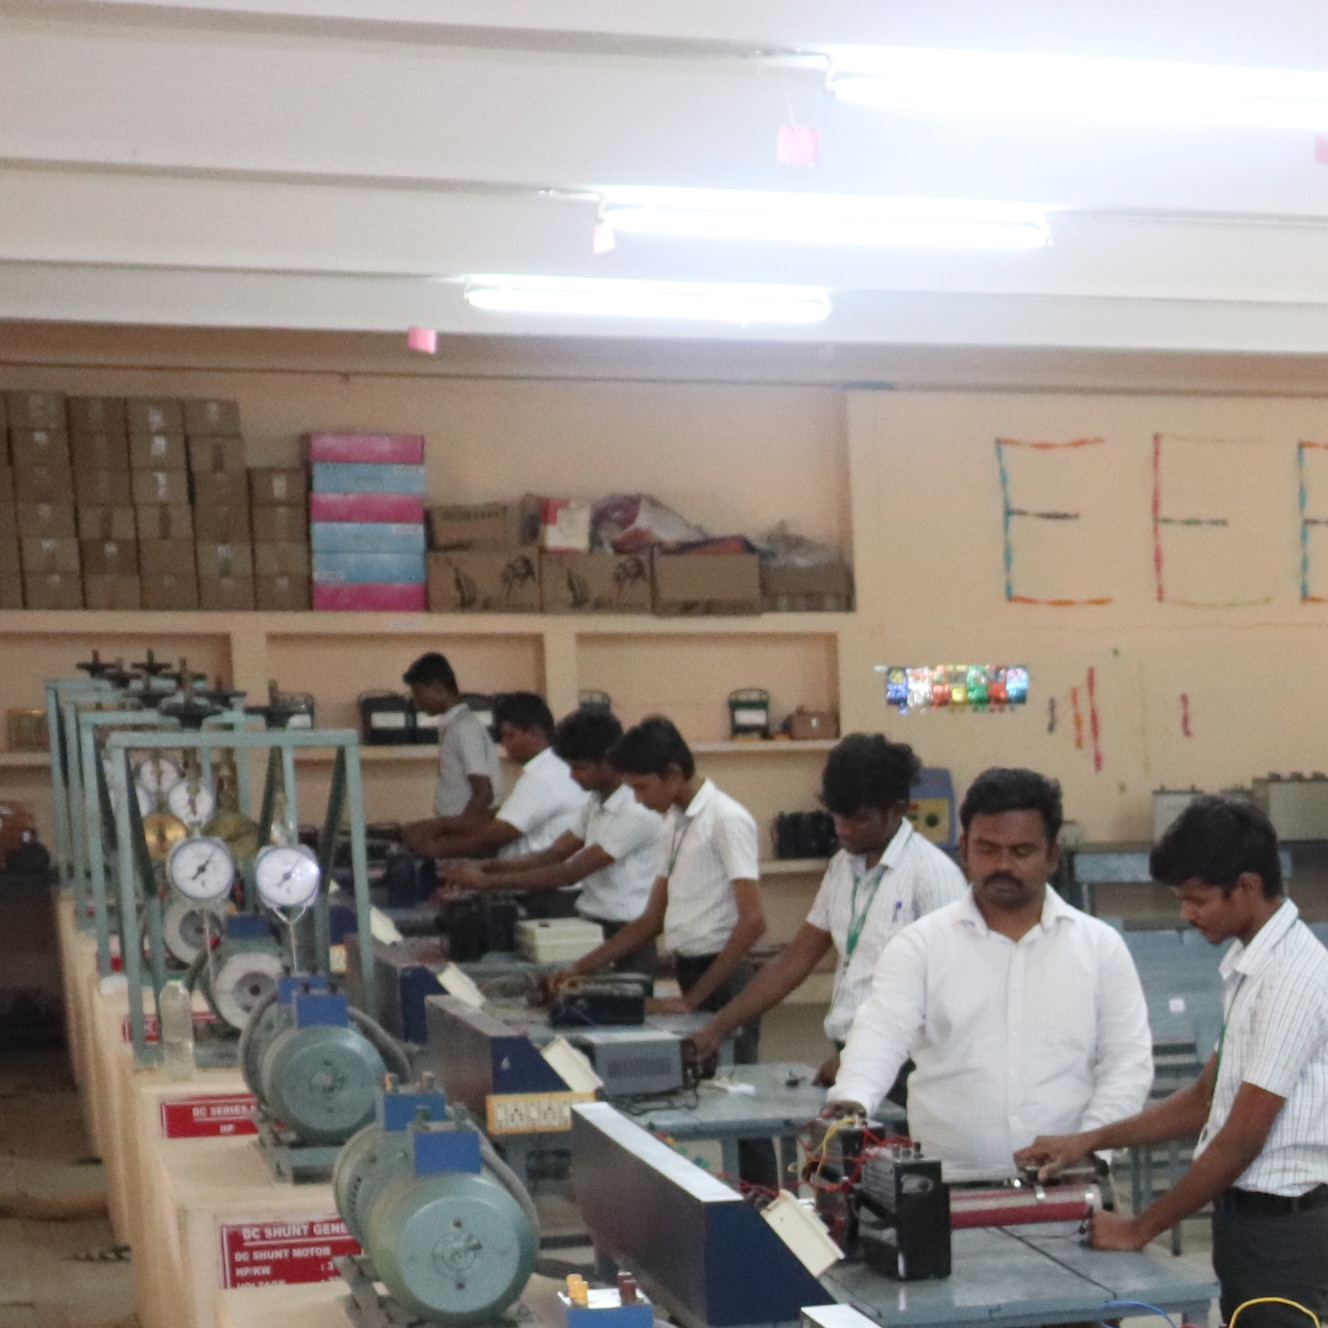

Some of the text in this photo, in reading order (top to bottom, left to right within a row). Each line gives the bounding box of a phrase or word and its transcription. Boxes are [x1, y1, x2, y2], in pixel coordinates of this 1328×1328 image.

[242, 1228, 260, 1240] DC
[264, 1224, 309, 1239] SHUNT
[234, 1246, 331, 1262] DC SHUNT MOTOR
